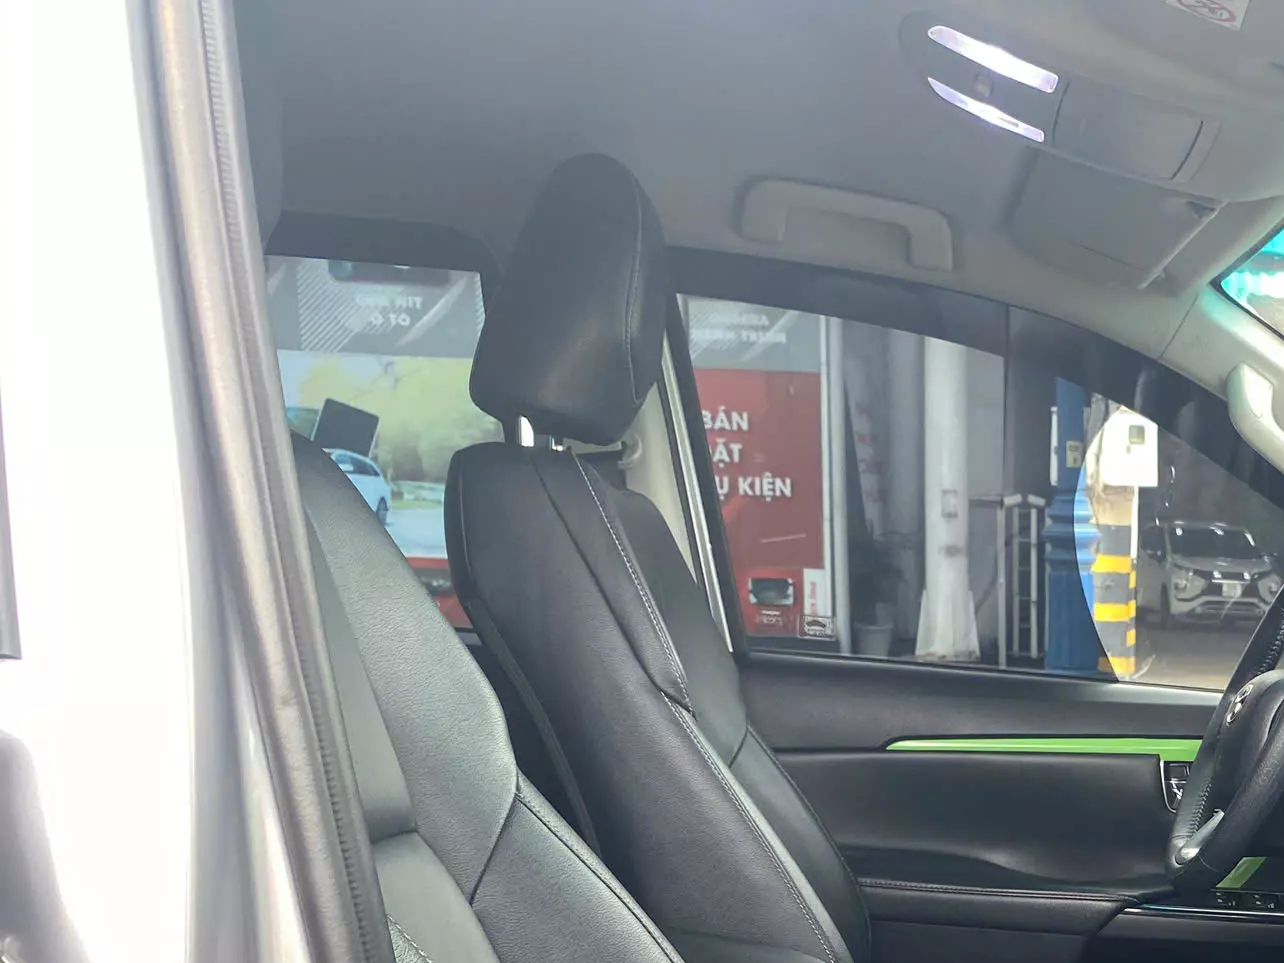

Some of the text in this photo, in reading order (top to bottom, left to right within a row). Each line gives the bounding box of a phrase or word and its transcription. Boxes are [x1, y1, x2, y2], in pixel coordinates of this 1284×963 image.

[702, 405, 749, 431] BÁN
[710, 438, 743, 468] ẶT
[738, 471, 792, 502] KIỆN
